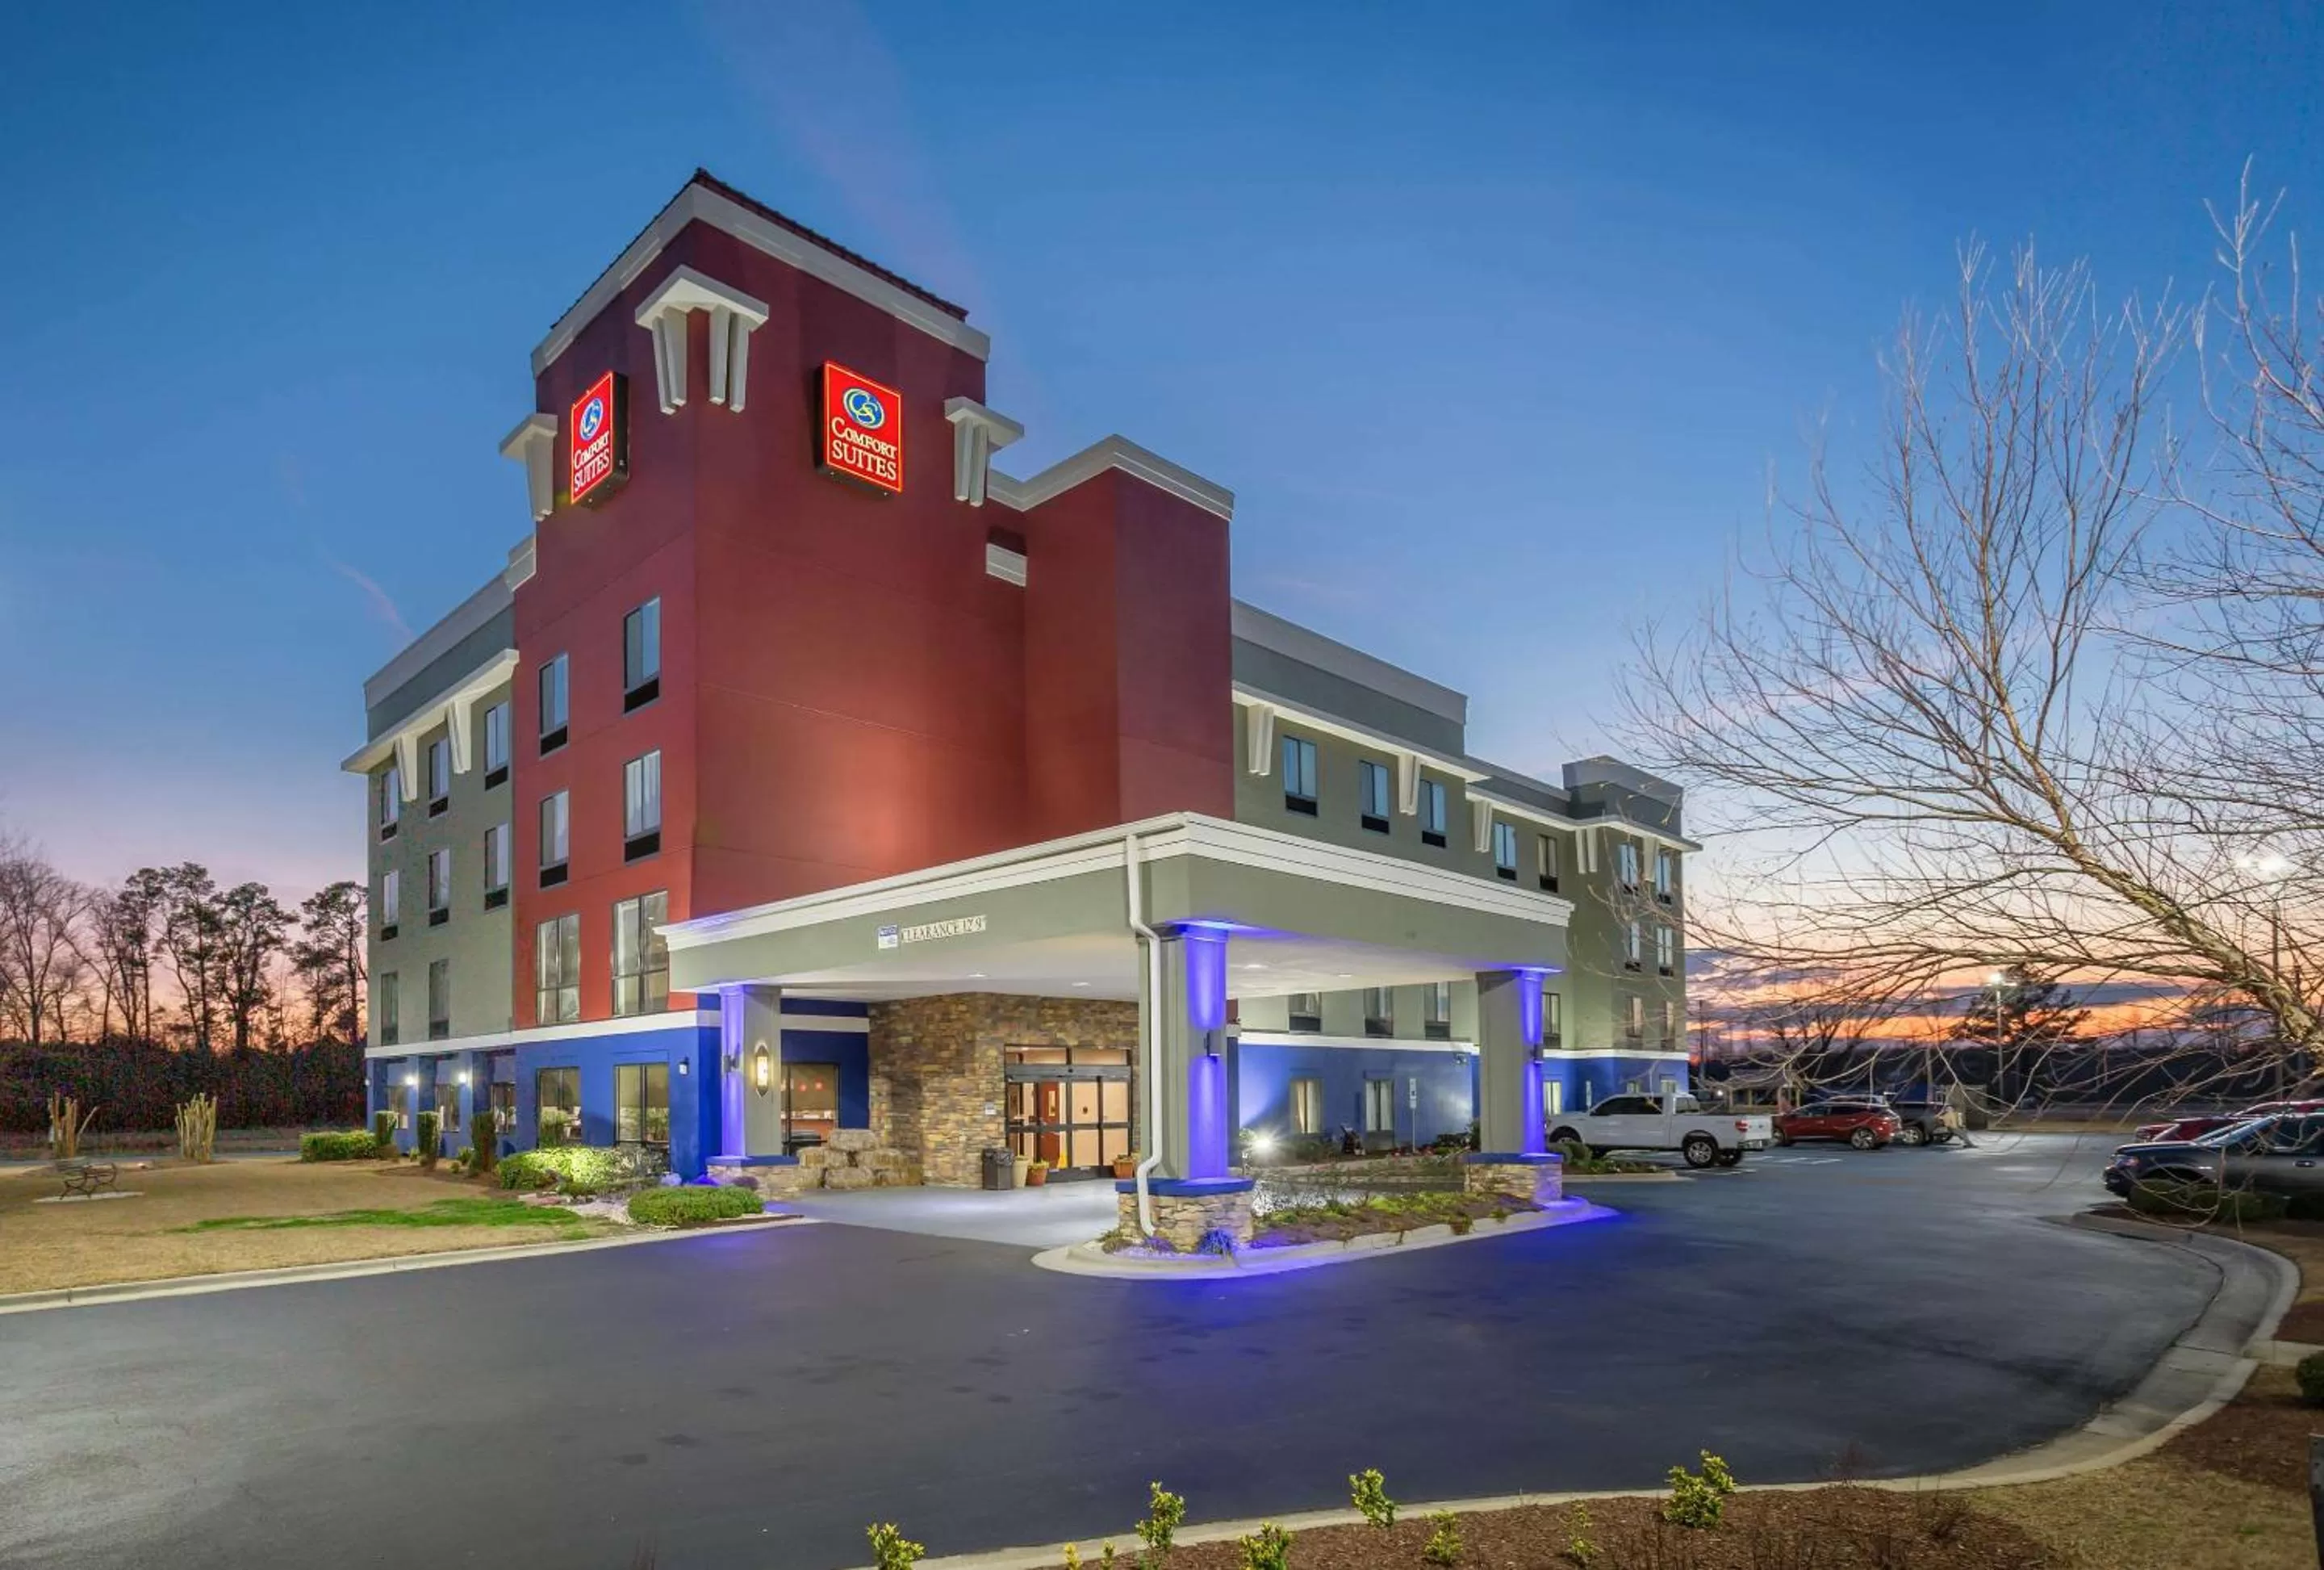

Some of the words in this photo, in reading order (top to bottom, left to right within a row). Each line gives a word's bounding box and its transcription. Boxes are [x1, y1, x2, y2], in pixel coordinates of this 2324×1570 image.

[831, 417, 897, 459] COMFORT
[574, 448, 610, 492] SUITES
[832, 439, 897, 480] SUITES
[901, 921, 959, 941] CLEARANCE
